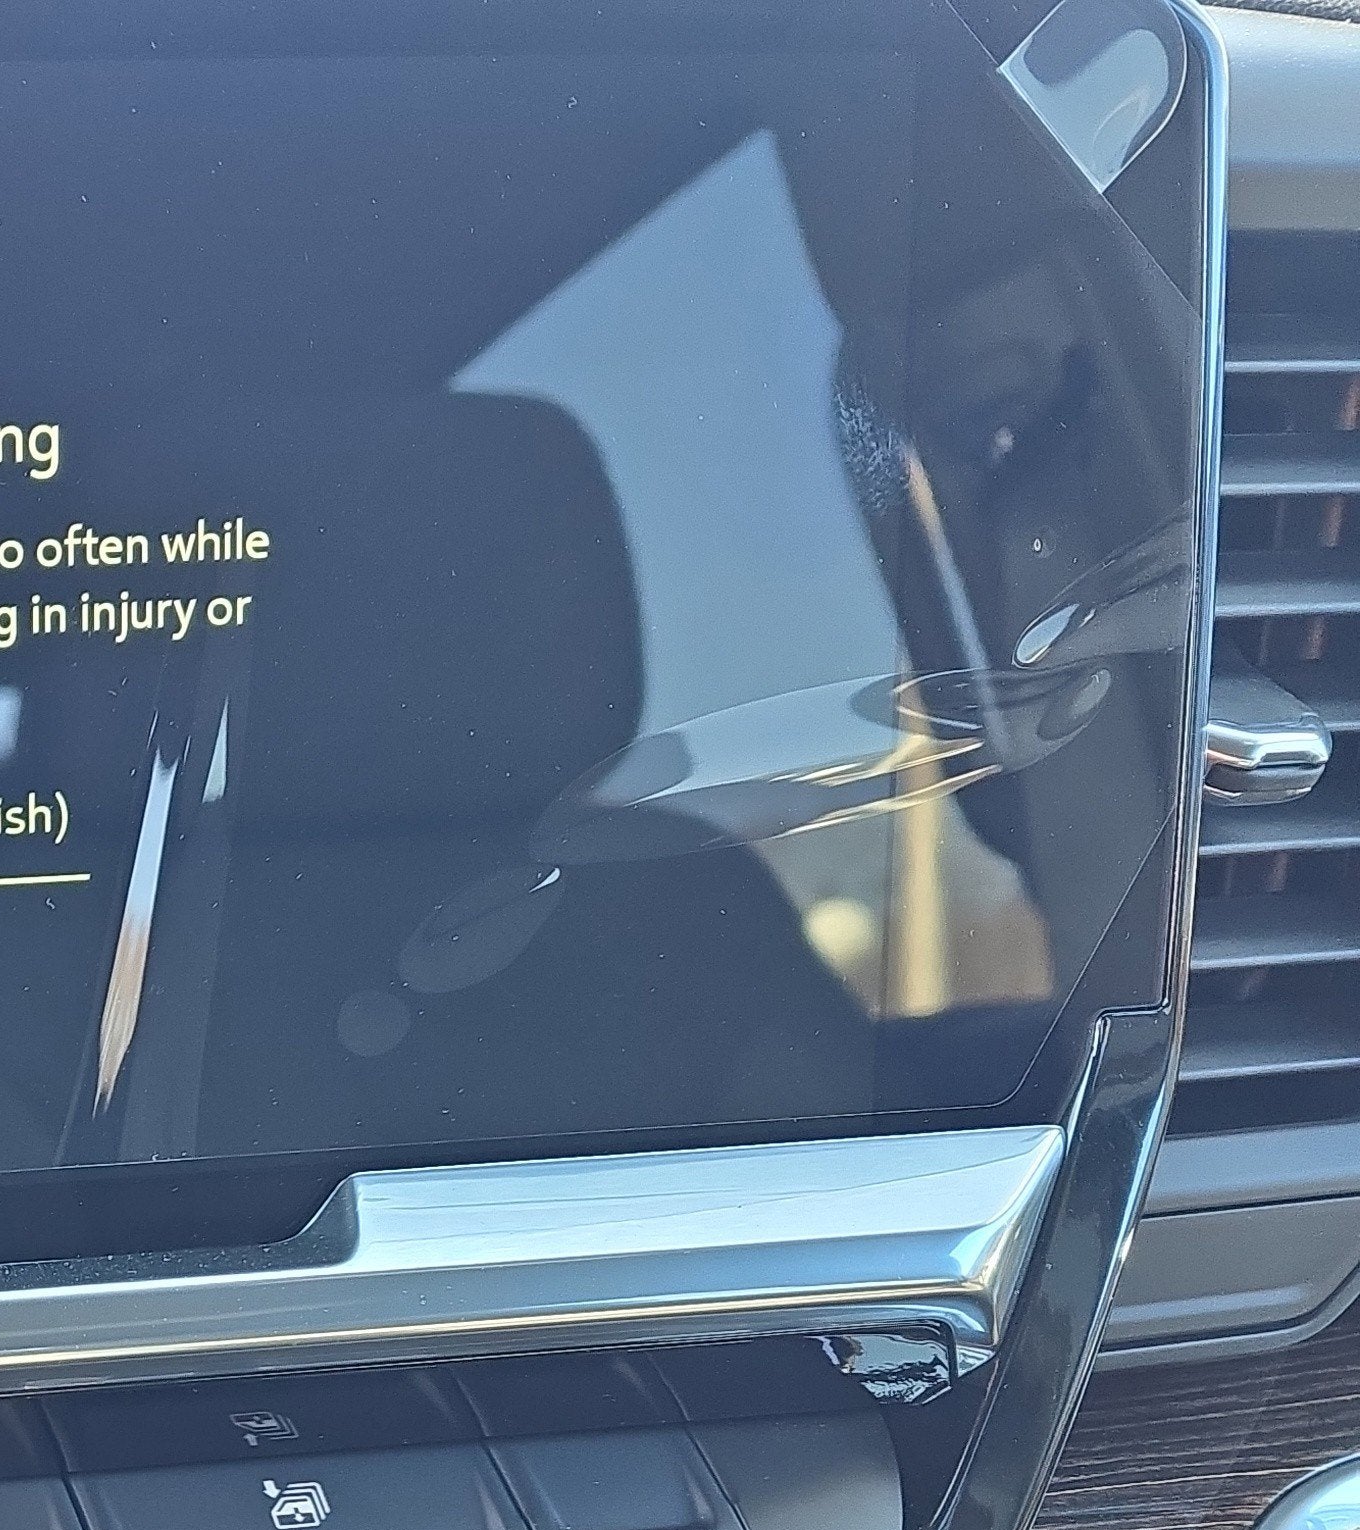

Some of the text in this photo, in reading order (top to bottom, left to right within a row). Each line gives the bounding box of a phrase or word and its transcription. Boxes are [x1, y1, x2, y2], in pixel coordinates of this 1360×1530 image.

[35, 523, 149, 568] often
[160, 517, 270, 563] while
[30, 594, 67, 634] in
[80, 591, 197, 643] injury
[206, 596, 253, 626] or
